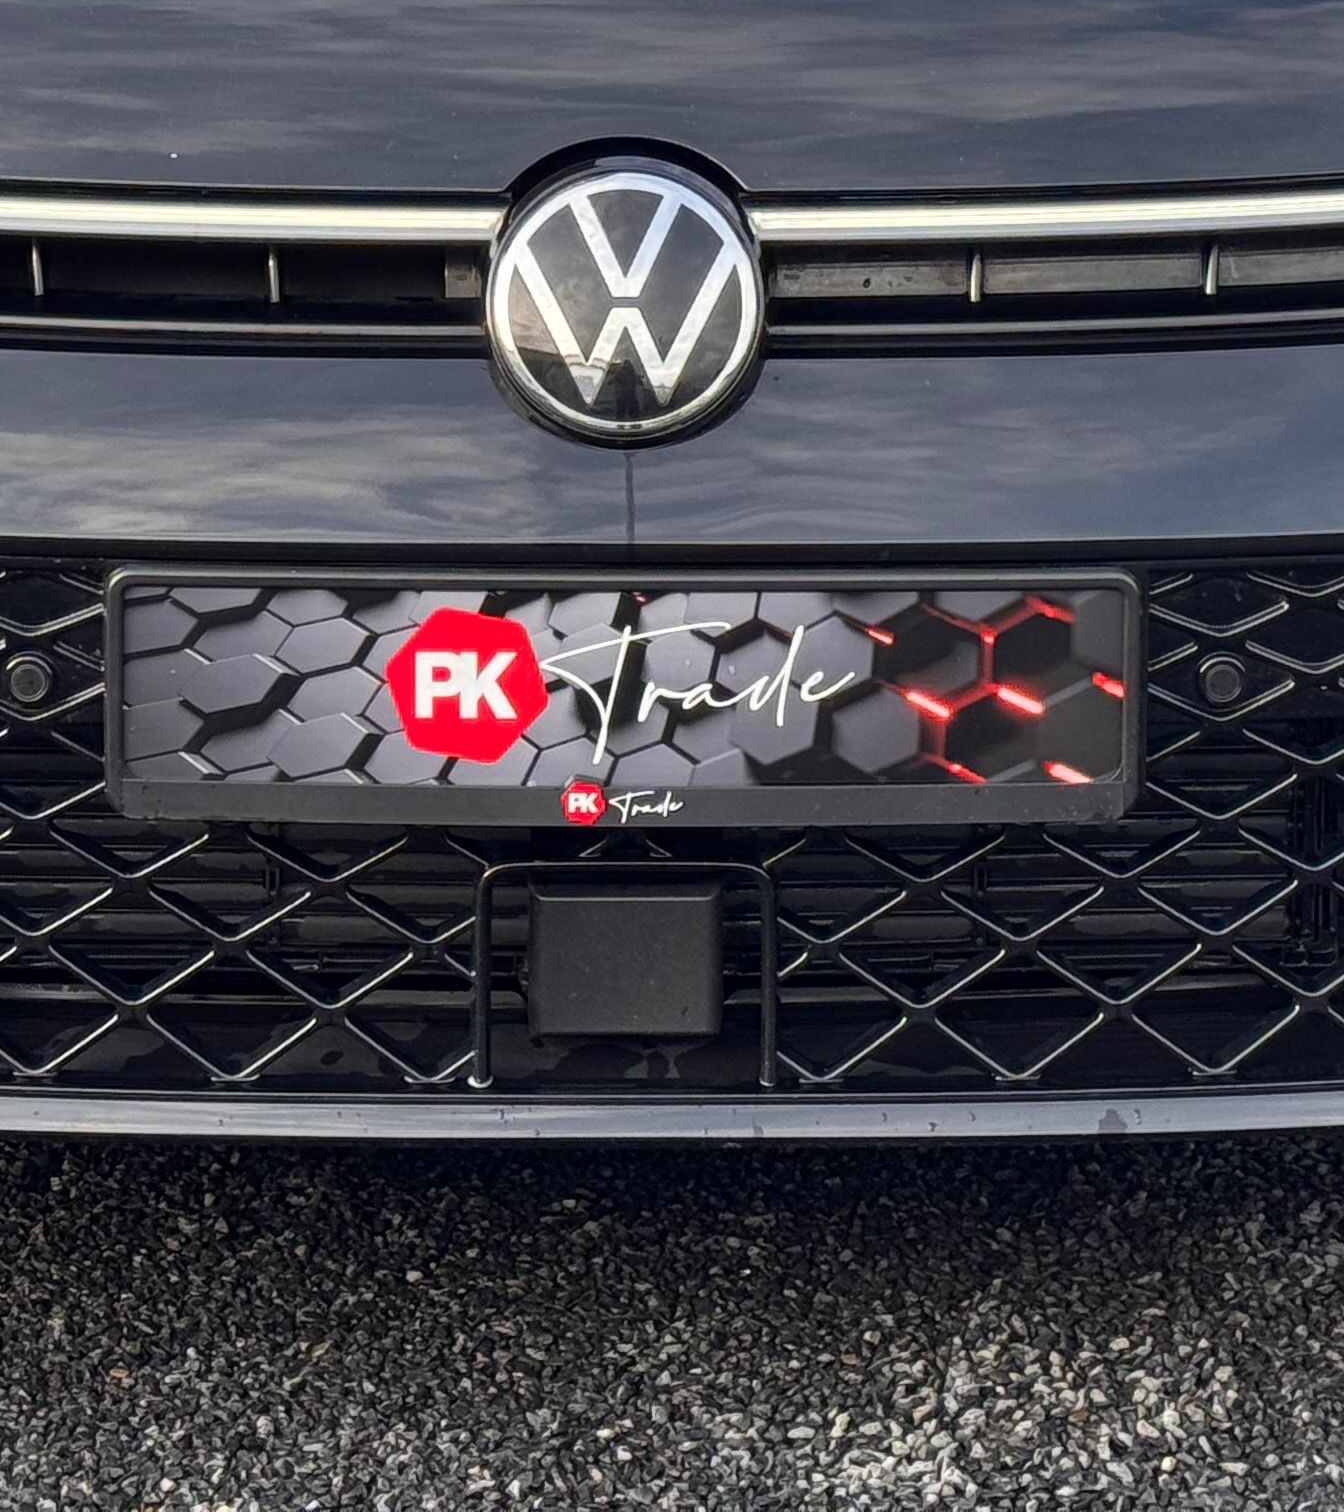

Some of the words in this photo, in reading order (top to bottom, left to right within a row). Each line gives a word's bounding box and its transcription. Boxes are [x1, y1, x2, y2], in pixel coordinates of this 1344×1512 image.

[504, 180, 742, 412] VW
[414, 651, 518, 720] PK
[539, 622, 856, 765] Trade
[568, 792, 598, 814] PK
[608, 790, 684, 824] Trade
